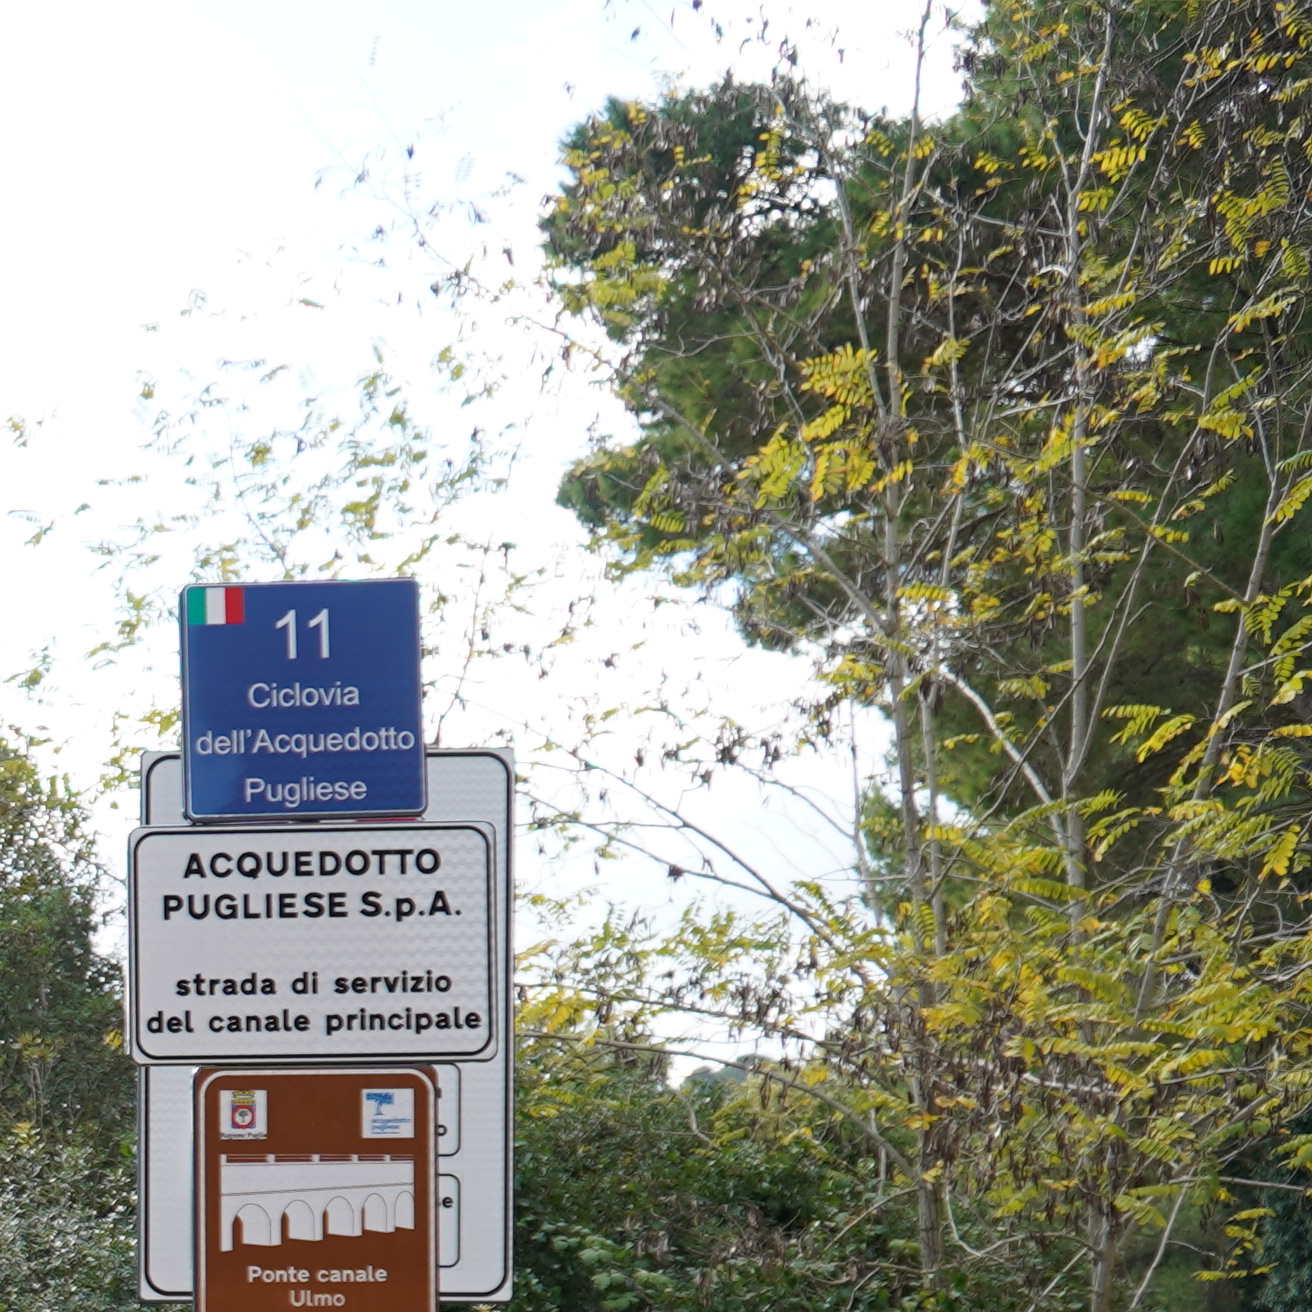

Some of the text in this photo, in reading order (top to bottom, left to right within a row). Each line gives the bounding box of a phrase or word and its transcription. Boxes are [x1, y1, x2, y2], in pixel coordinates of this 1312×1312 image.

[276, 608, 330, 660] 11
[248, 682, 360, 708] Ciclovia
[196, 727, 415, 758] dell'Acquedotto
[245, 776, 368, 808] Pugliese
[183, 848, 441, 880] ACQUEDOTTO
[163, 890, 462, 923] PUGLIESE S.p.A.
[175, 969, 452, 997] strada di servizio
[146, 1006, 481, 1036] del canale principale
[247, 1265, 388, 1283] Ponte canale
[289, 1289, 346, 1307] Ulmo
